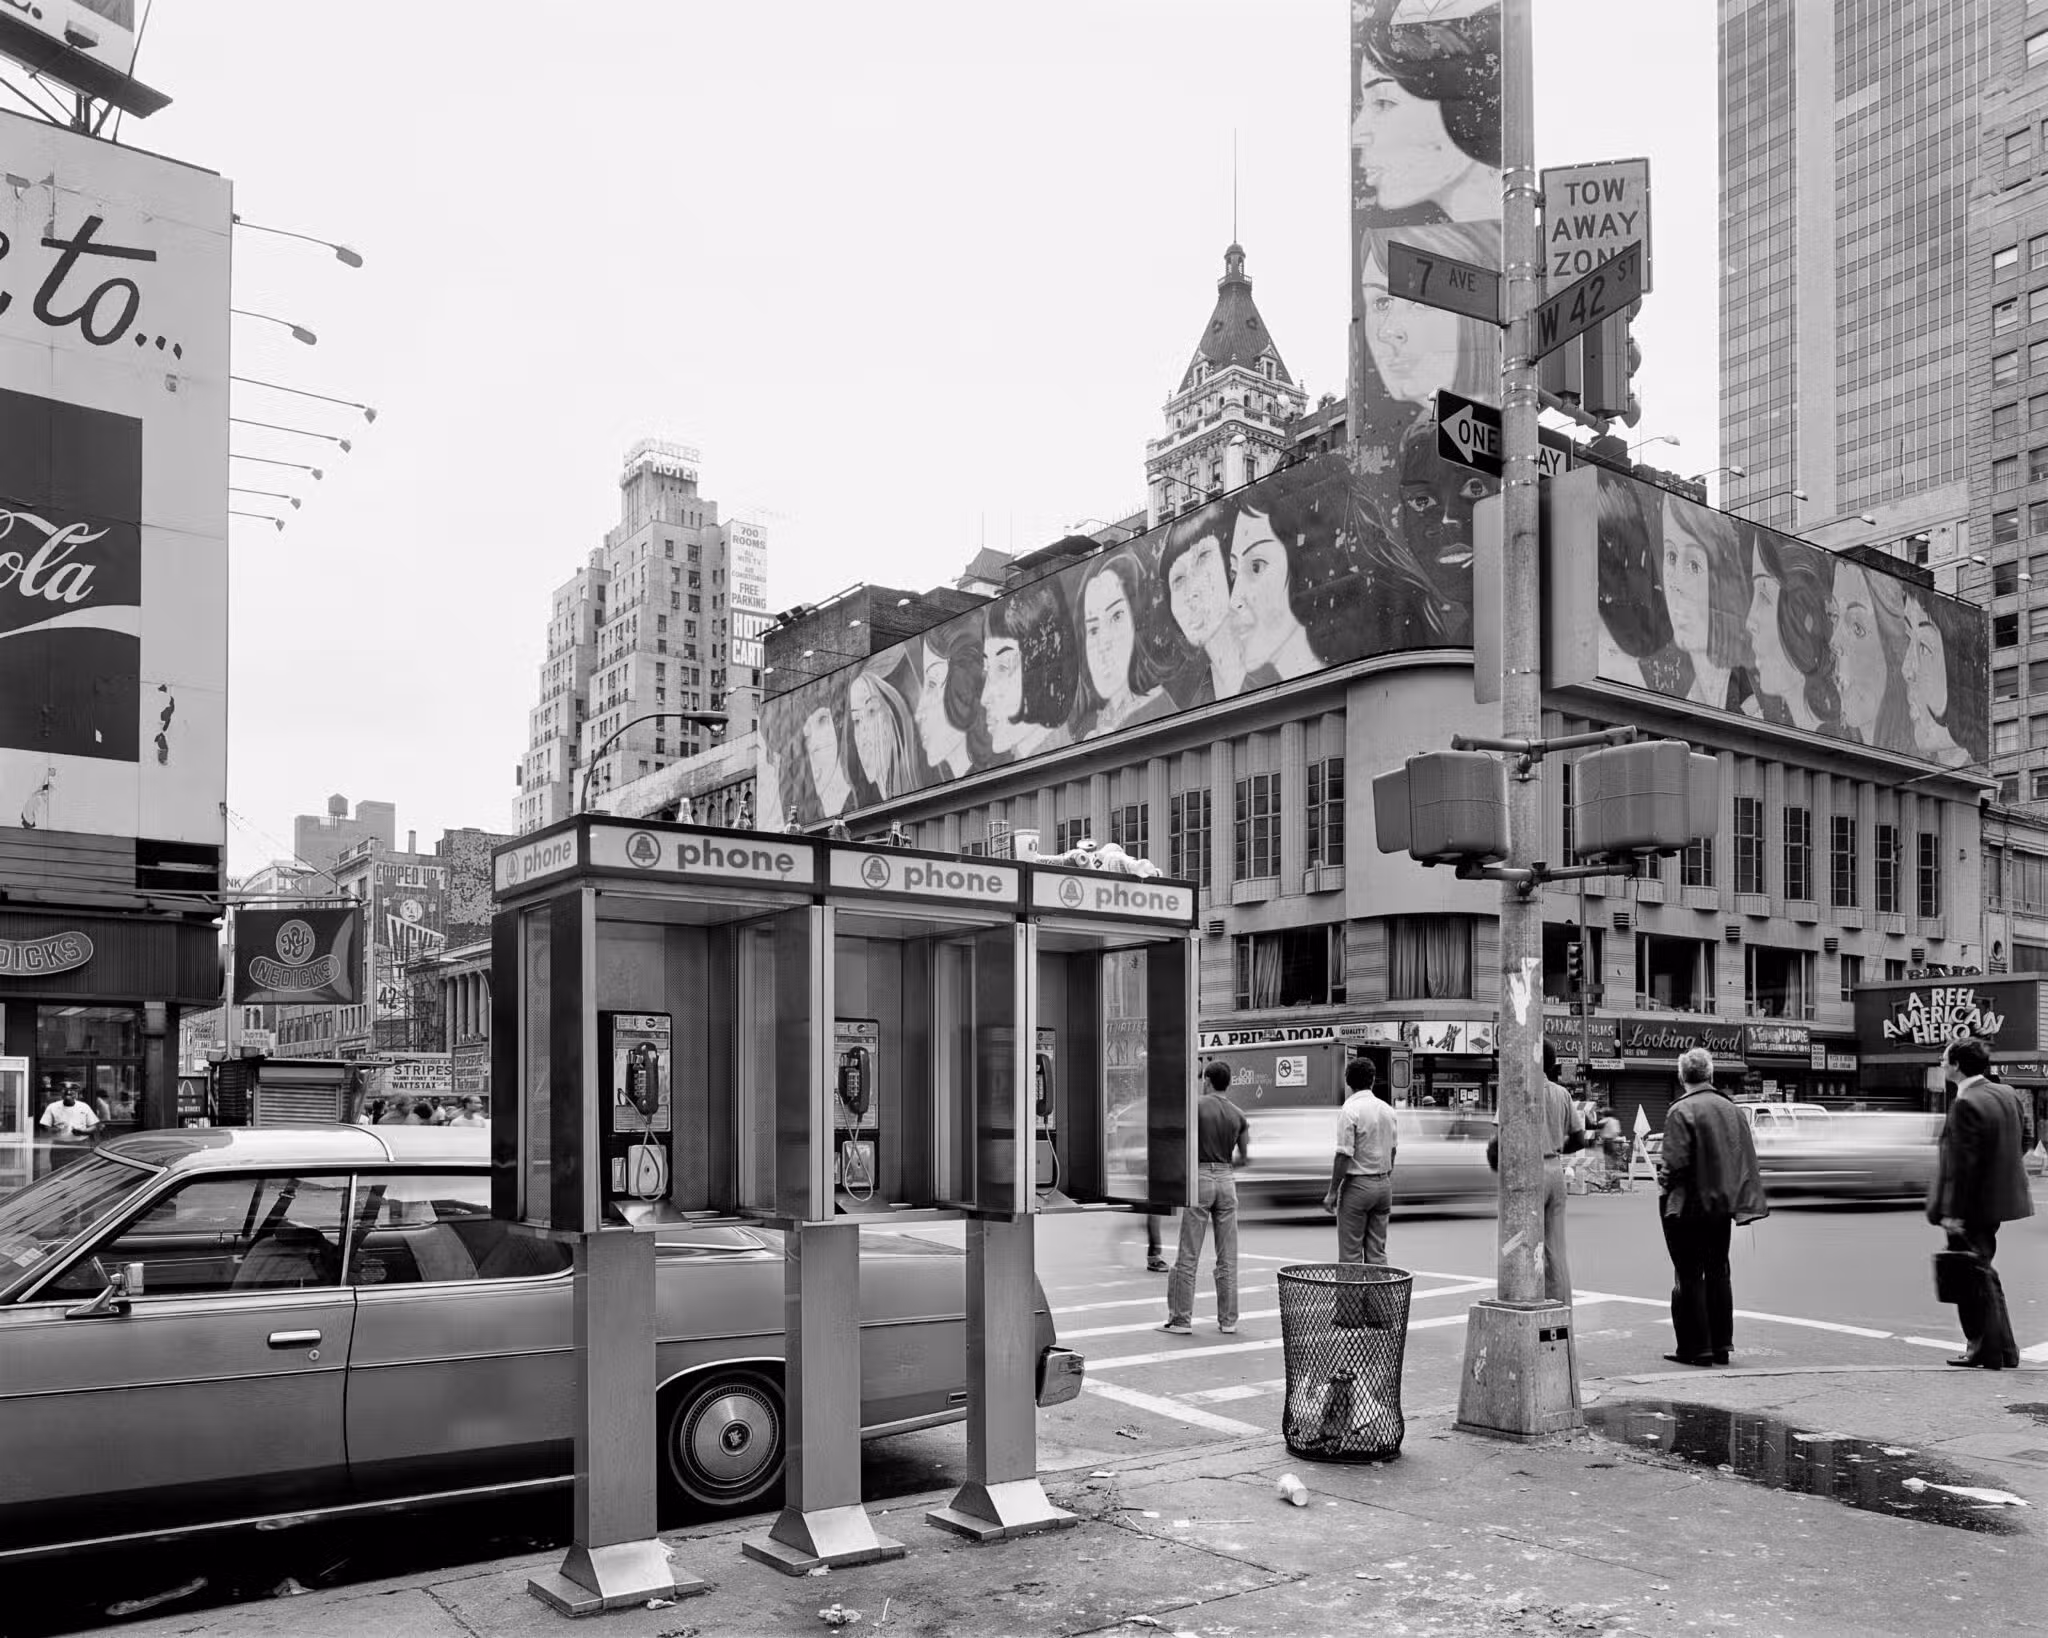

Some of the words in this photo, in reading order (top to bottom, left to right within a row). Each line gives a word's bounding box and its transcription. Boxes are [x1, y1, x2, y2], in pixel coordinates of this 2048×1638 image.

[1564, 178, 1625, 206] TOW
[1551, 210, 1638, 242] AWAY
[1553, 246, 1630, 278] ZON
[1416, 257, 1433, 297] 7
[1450, 269, 1476, 292] AVE
[1540, 303, 1560, 346] W
[1569, 275, 1605, 325] 42
[1617, 254, 1637, 282] ST
[1458, 418, 1499, 457] ONE
[1538, 448, 1561, 476] AY
[732, 535, 766, 549] ROOMS
[741, 526, 759, 538] 700
[731, 593, 767, 609] PARKING
[740, 582, 760, 596] FREE
[733, 640, 764, 668] CART
[523, 840, 572, 880] phone
[676, 838, 796, 874] phone
[226, 878, 241, 888] NK
[904, 861, 1003, 894] phone
[1095, 882, 1180, 912] phone
[255, 960, 335, 989] NEDICKS
[1908, 992, 1924, 1011] A
[1931, 988, 1977, 1008] REEL
[1341, 1028, 1365, 1036] QUALITY
[1545, 1018, 1581, 1035] ODAK
[1883, 1005, 2005, 1038] AMERICAN
[1912, 1023, 1971, 1044] HERO
[1565, 1040, 1604, 1053] CARA
[1626, 1024, 1696, 1050] Looking
[1702, 1027, 1741, 1051] Good
[394, 1065, 452, 1075] STRIPES
